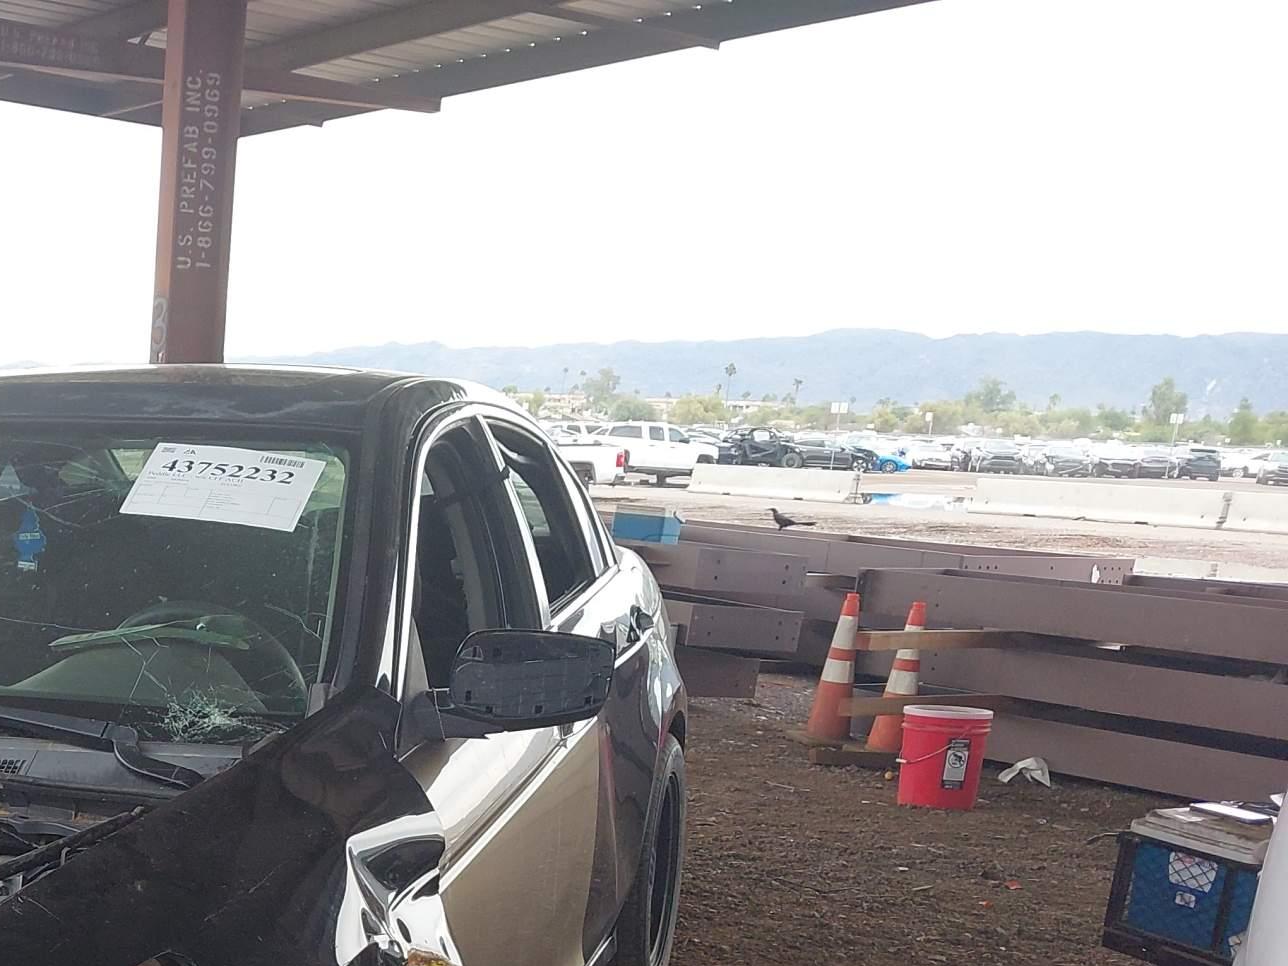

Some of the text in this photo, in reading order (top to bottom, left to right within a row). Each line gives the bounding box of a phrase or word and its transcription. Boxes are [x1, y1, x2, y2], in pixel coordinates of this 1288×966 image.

[176, 69, 203, 269] U.S. PREFAB INC.
[196, 72, 221, 268] 1-866-799-0969
[161, 459, 295, 485] 43752232
